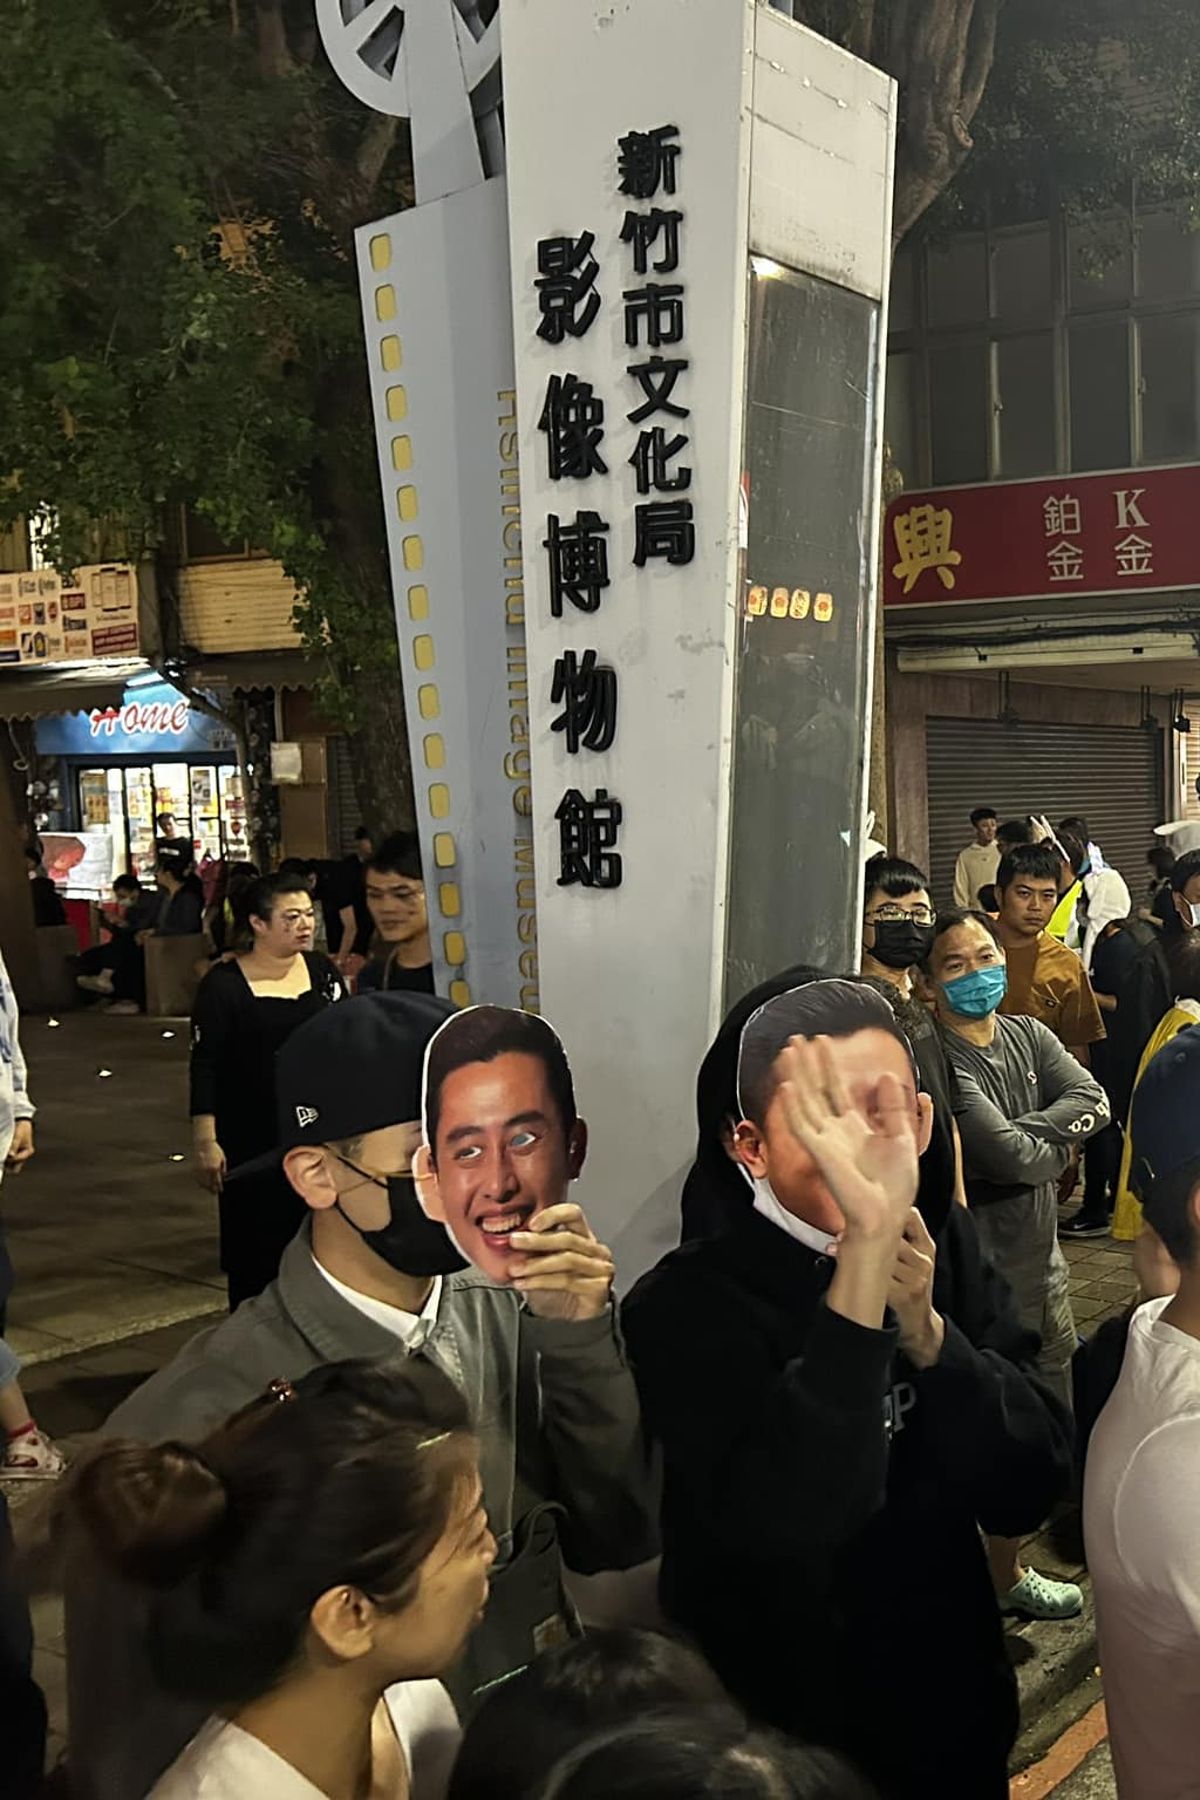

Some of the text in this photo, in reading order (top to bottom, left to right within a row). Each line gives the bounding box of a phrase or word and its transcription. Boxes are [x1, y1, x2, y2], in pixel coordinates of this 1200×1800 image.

[616, 124, 696, 568] 新竹市文化局
[533, 230, 623, 889] 影像博物館
[892, 503, 962, 595] 興
[1043, 494, 1084, 582] 鉑金
[1112, 488, 1154, 576] K金
[512, 836, 542, 1015] Museu
